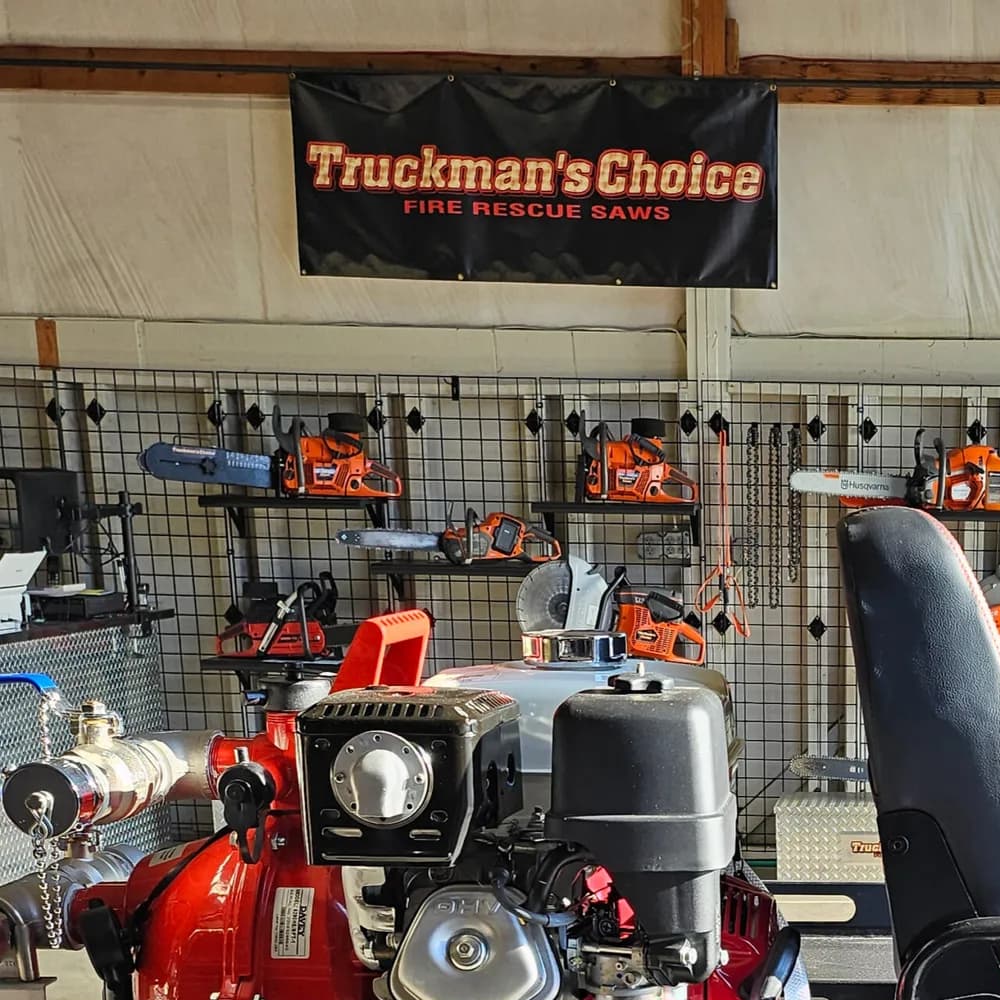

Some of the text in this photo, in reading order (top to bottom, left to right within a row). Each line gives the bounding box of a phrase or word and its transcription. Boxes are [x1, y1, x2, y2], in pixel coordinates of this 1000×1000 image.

[306, 141, 767, 200] Truckman's Choice
[403, 200, 671, 220] FIRE RESCUE SAWS
[849, 480, 890, 492] Husqvarna
[438, 896, 501, 914] OHV
[299, 905, 307, 937] DAVEY
